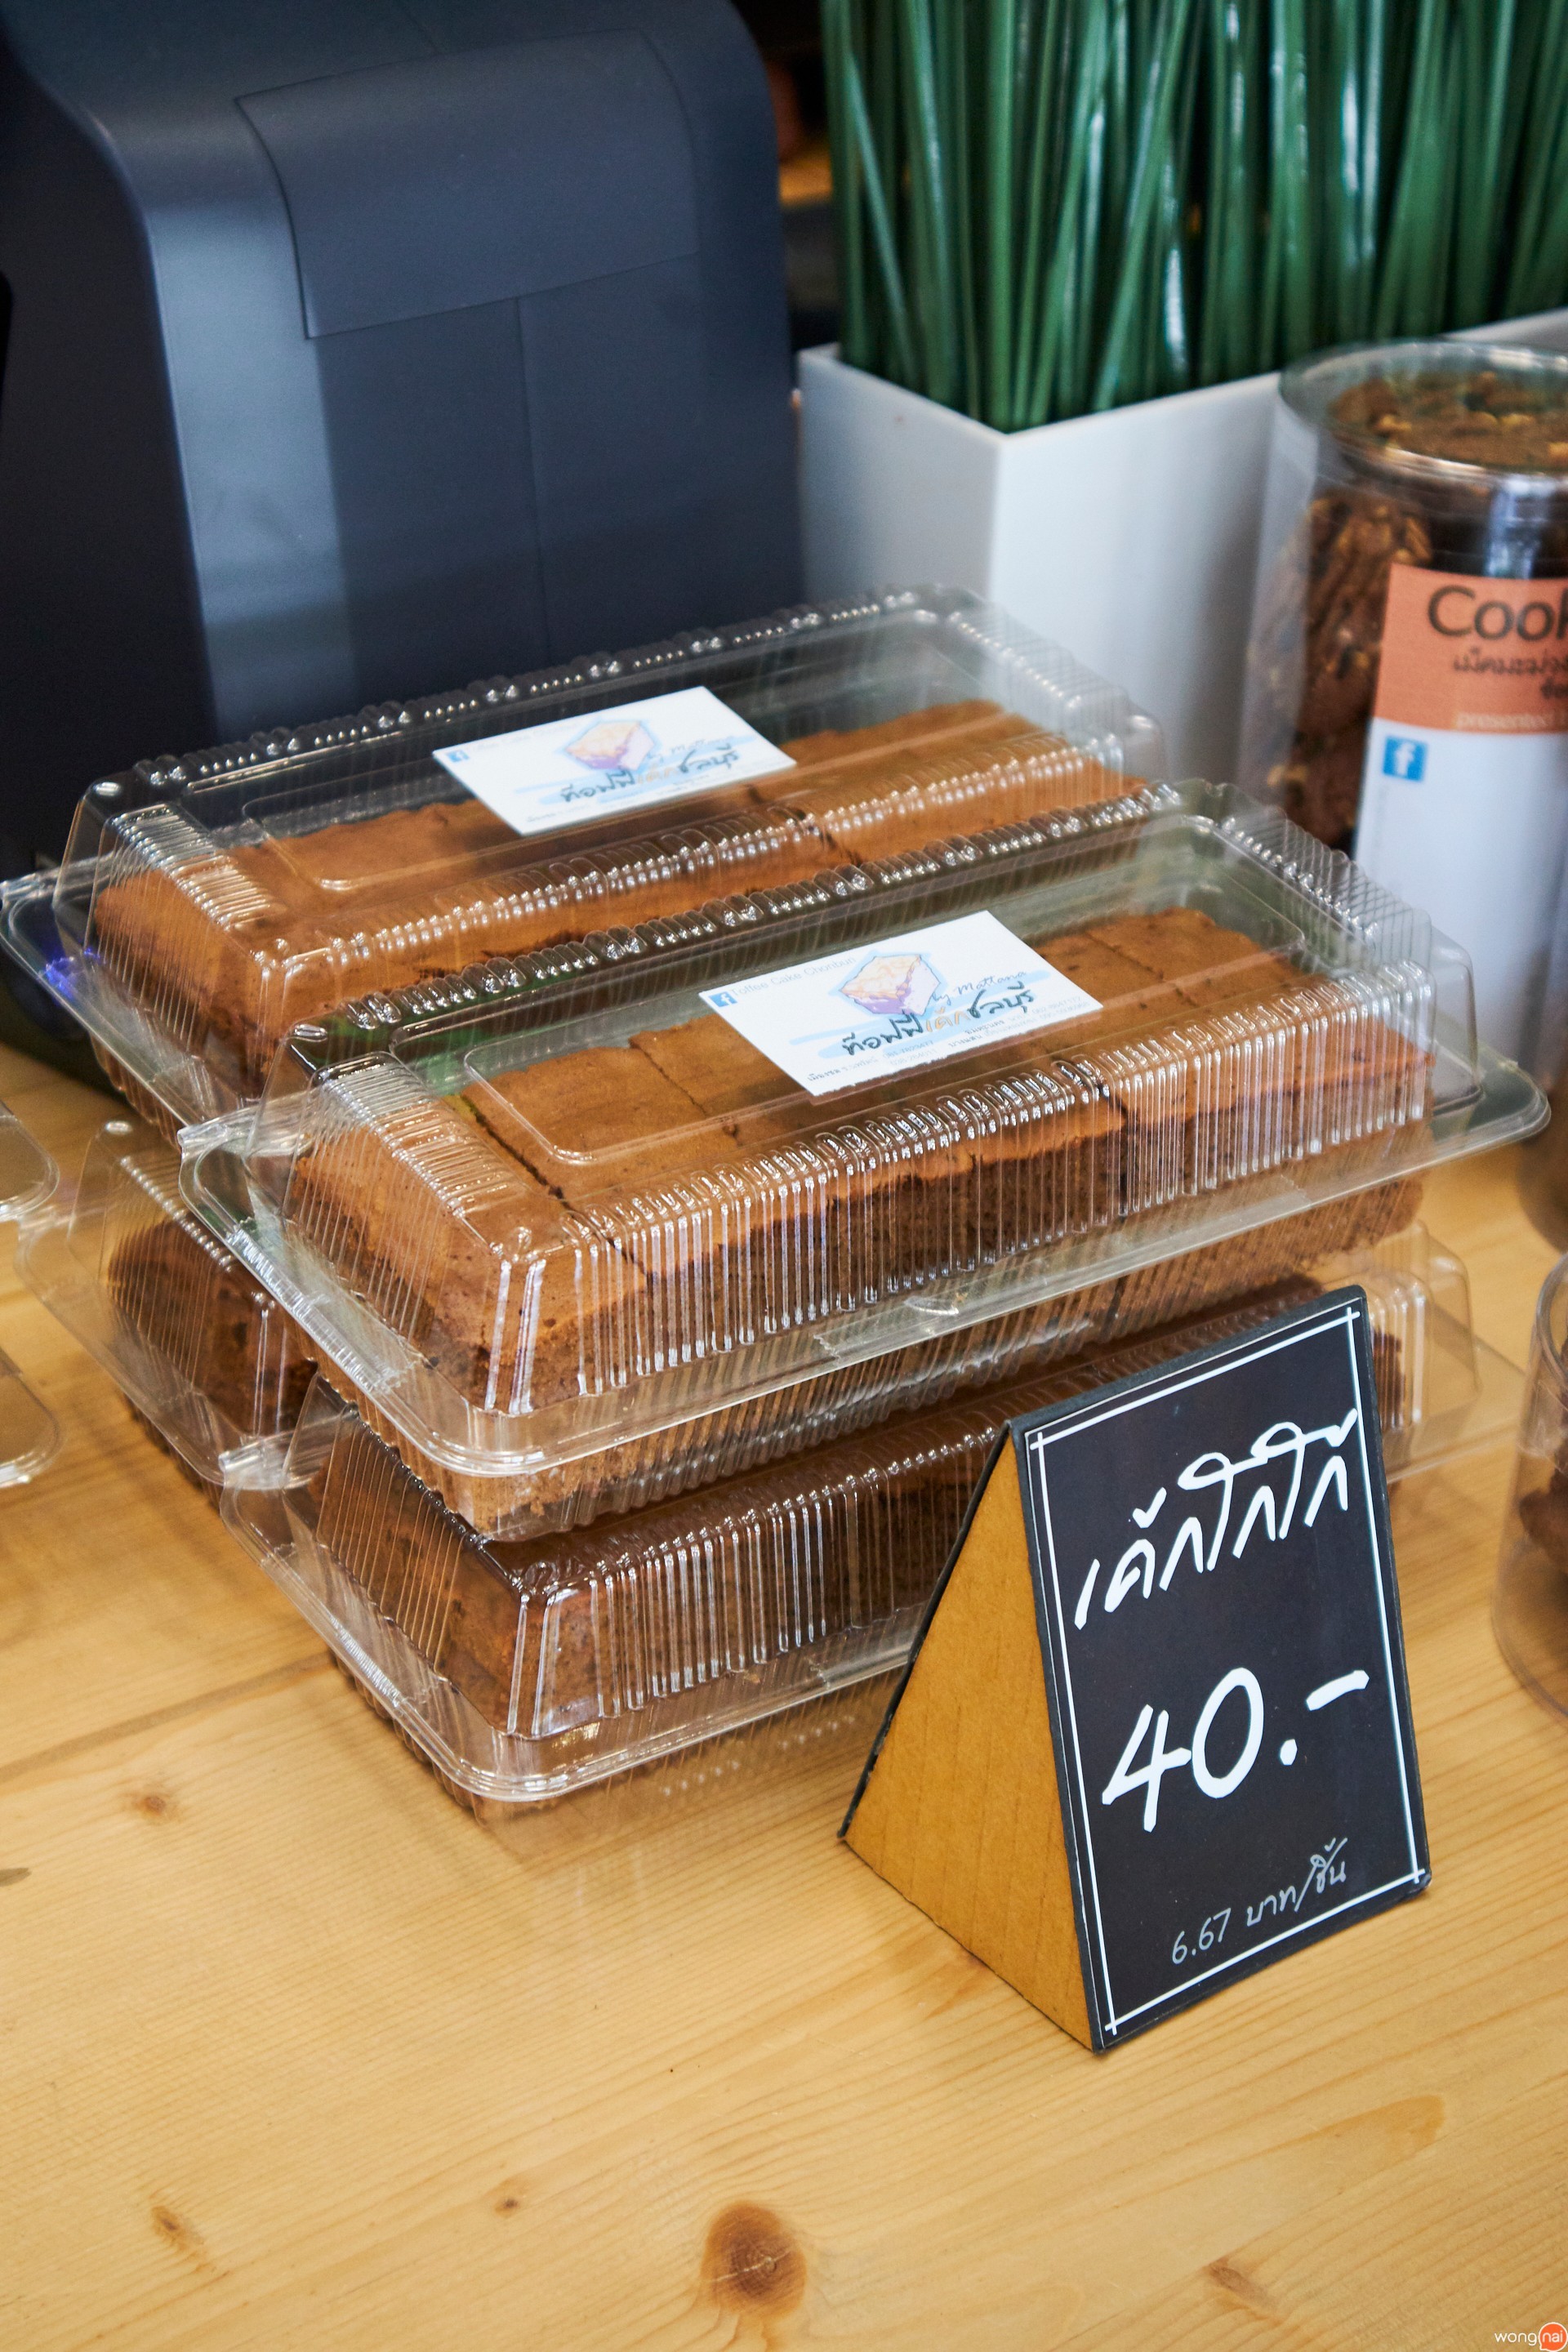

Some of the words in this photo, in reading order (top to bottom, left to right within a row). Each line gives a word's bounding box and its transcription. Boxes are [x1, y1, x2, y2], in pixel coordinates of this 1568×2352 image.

[732, 982, 768, 996] Toffee
[771, 972, 802, 985] Cake
[1172, 1908, 1232, 1965] 6.67
